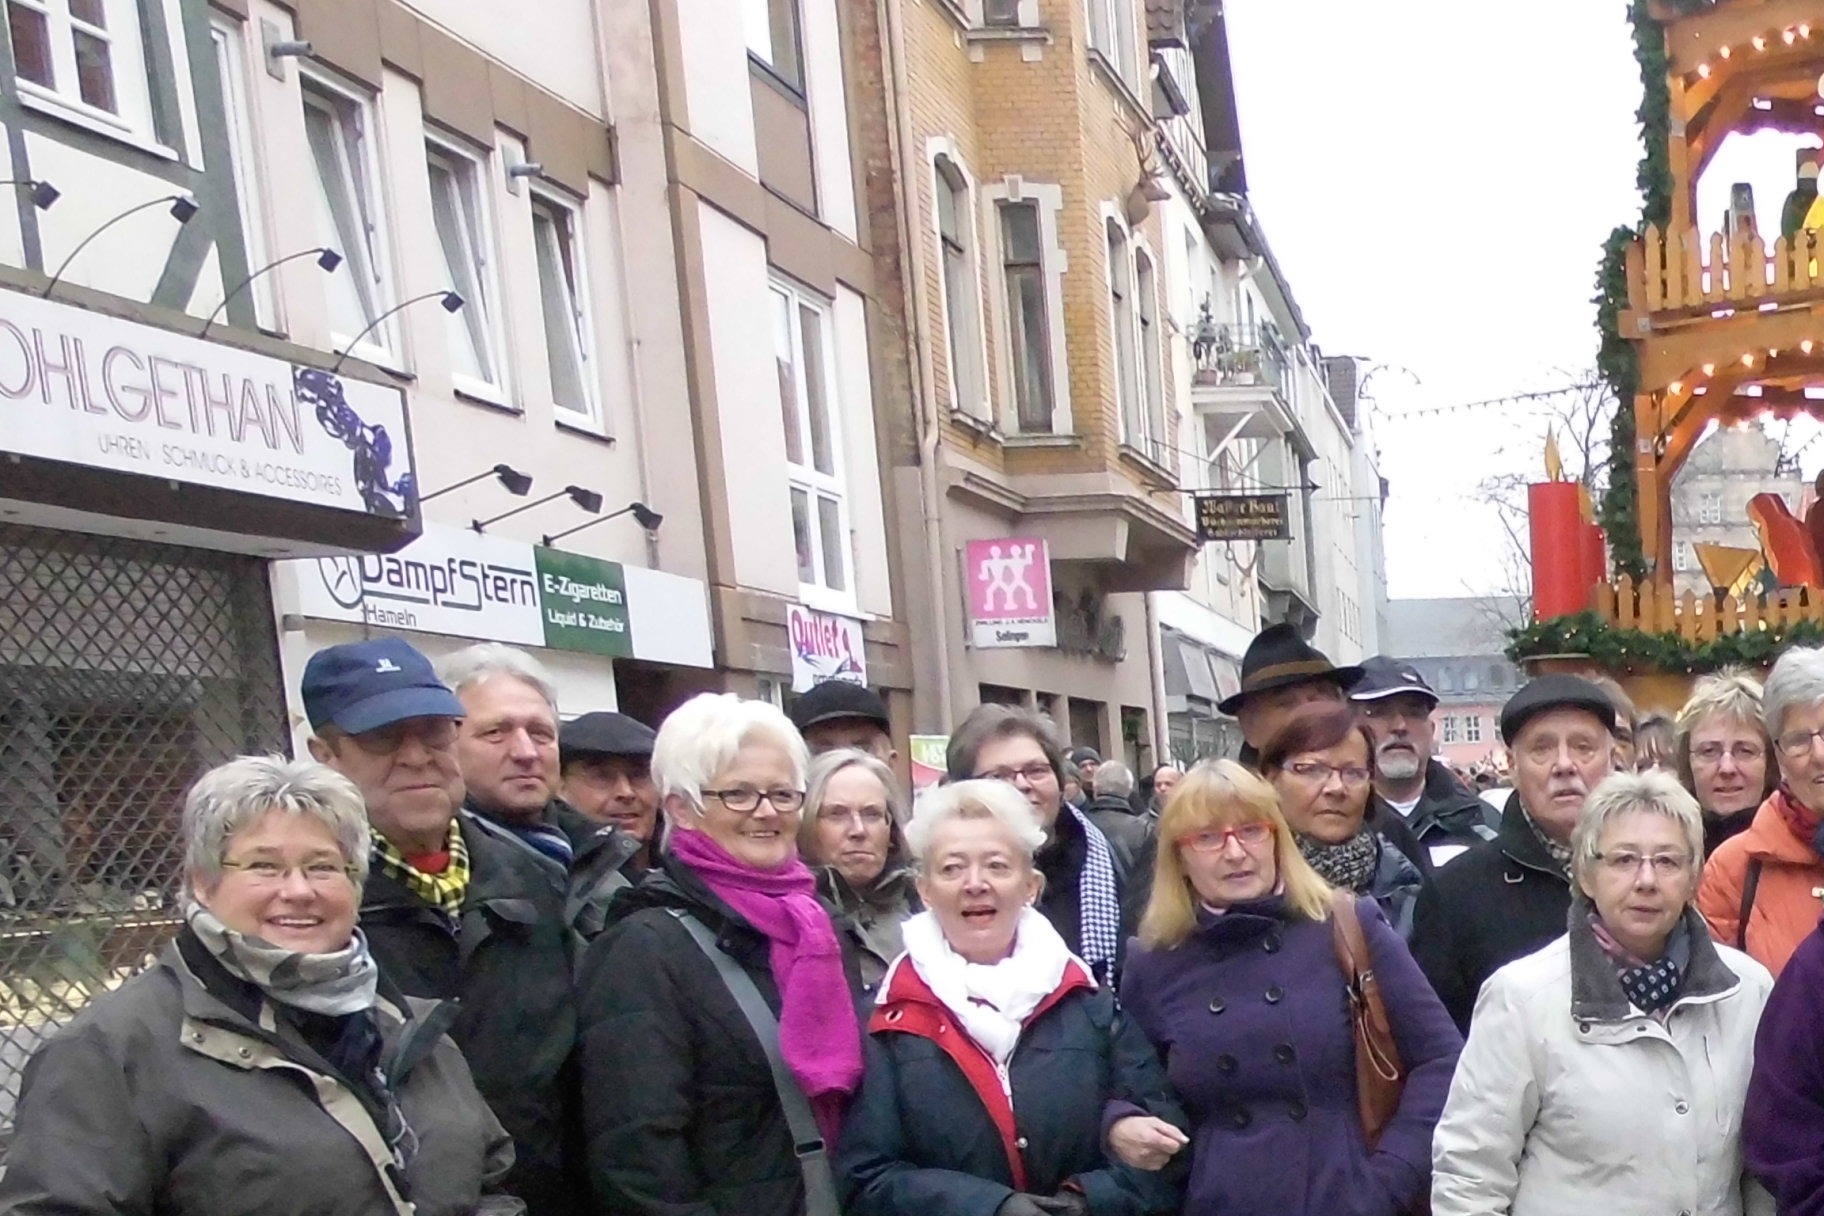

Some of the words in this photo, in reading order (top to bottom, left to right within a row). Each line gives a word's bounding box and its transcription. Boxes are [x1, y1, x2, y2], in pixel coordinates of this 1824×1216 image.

[97, 434, 151, 461] UHREN
[162, 443, 236, 477] SCHMUCK
[240, 458, 251, 479] &
[254, 463, 343, 497] ACCESSOIRES
[542, 572, 623, 605] E-Zigaretten
[366, 603, 417, 627] Hameln
[547, 607, 578, 628] Liquid
[578, 612, 588, 628] &
[587, 614, 625, 633] Zubehör
[791, 608, 841, 658] Outlet
